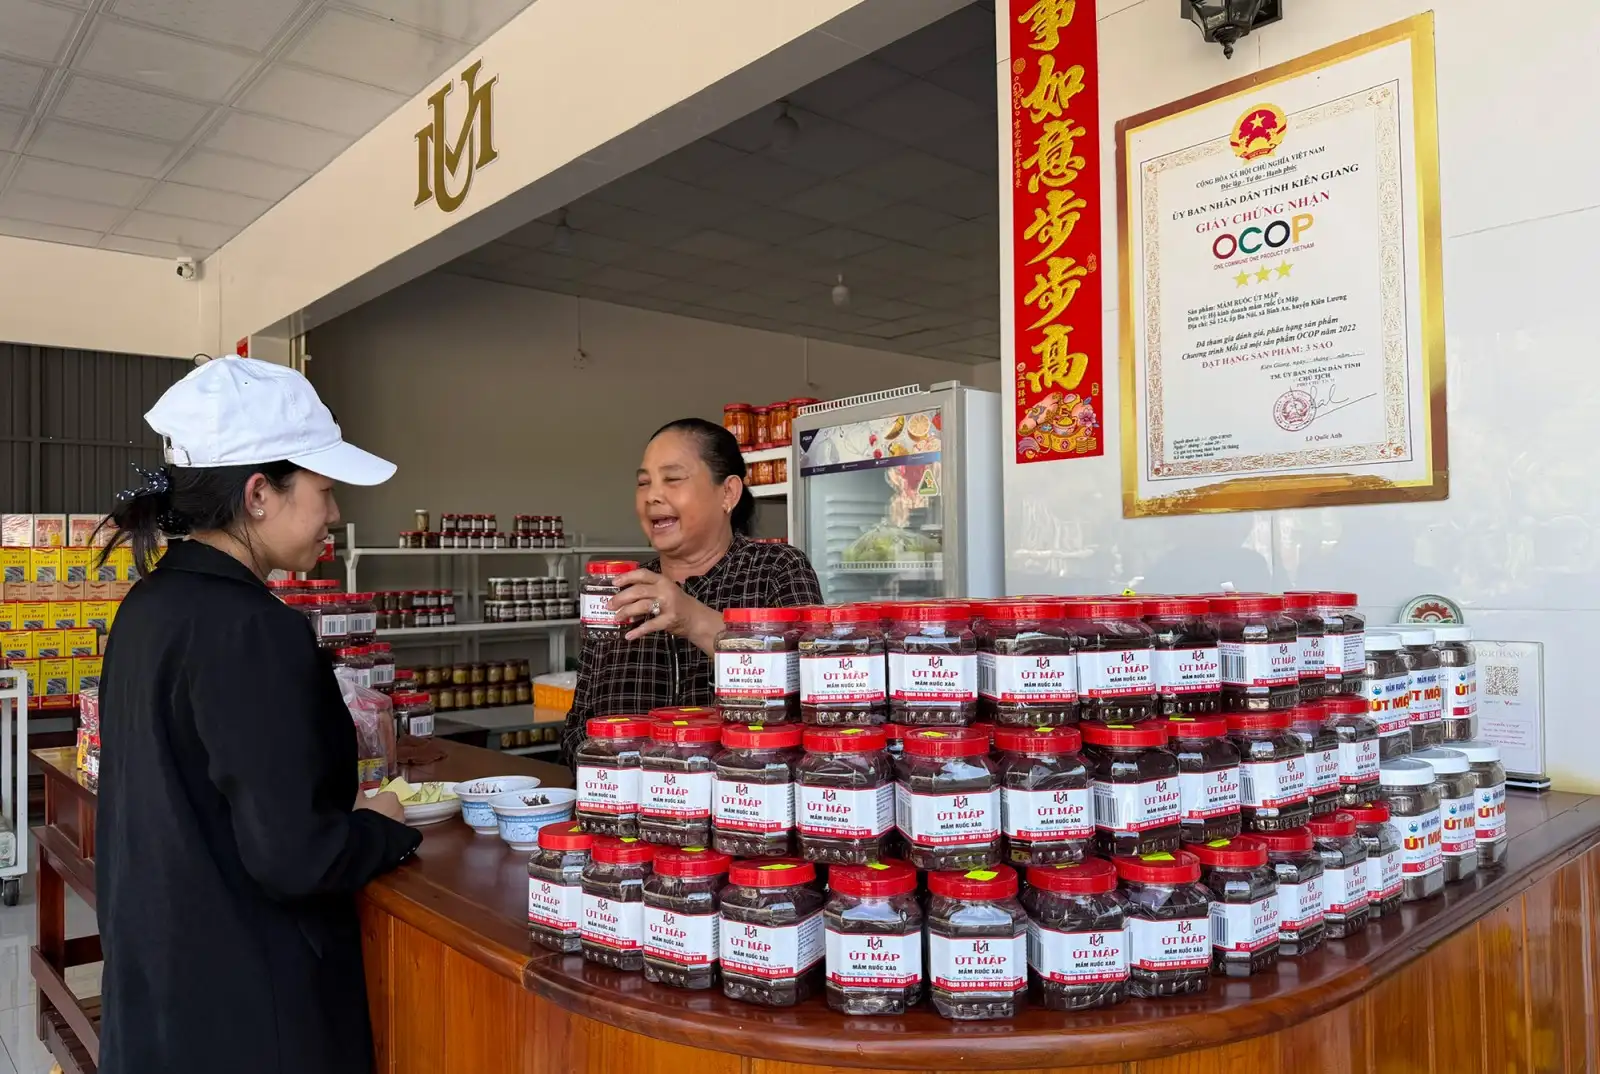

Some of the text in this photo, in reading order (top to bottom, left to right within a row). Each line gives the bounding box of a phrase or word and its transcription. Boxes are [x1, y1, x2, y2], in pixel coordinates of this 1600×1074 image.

[1172, 163, 1359, 220] ỦY BAN NHÂN DÂN TỈNH KIÊN GIANG
[1196, 190, 1330, 233] GIẤY CHỨNG NHẬN
[1212, 213, 1314, 259] OCOP
[1225, 259, 1248, 268] COMMUNE
[1260, 250, 1283, 259] PRODUCT
[1292, 242, 1315, 252] VIETNAM
[1021, 670, 1038, 680] ÚT
[807, 801, 824, 811] ÚT
[1038, 806, 1056, 815] ÚT
[937, 811, 956, 820] ÚT
[730, 936, 745, 947] ÚT
[1162, 935, 1179, 945] ÚT
[849, 950, 868, 960] ÚT
[1072, 948, 1090, 958] ÚT
[955, 955, 974, 965] ÚT
